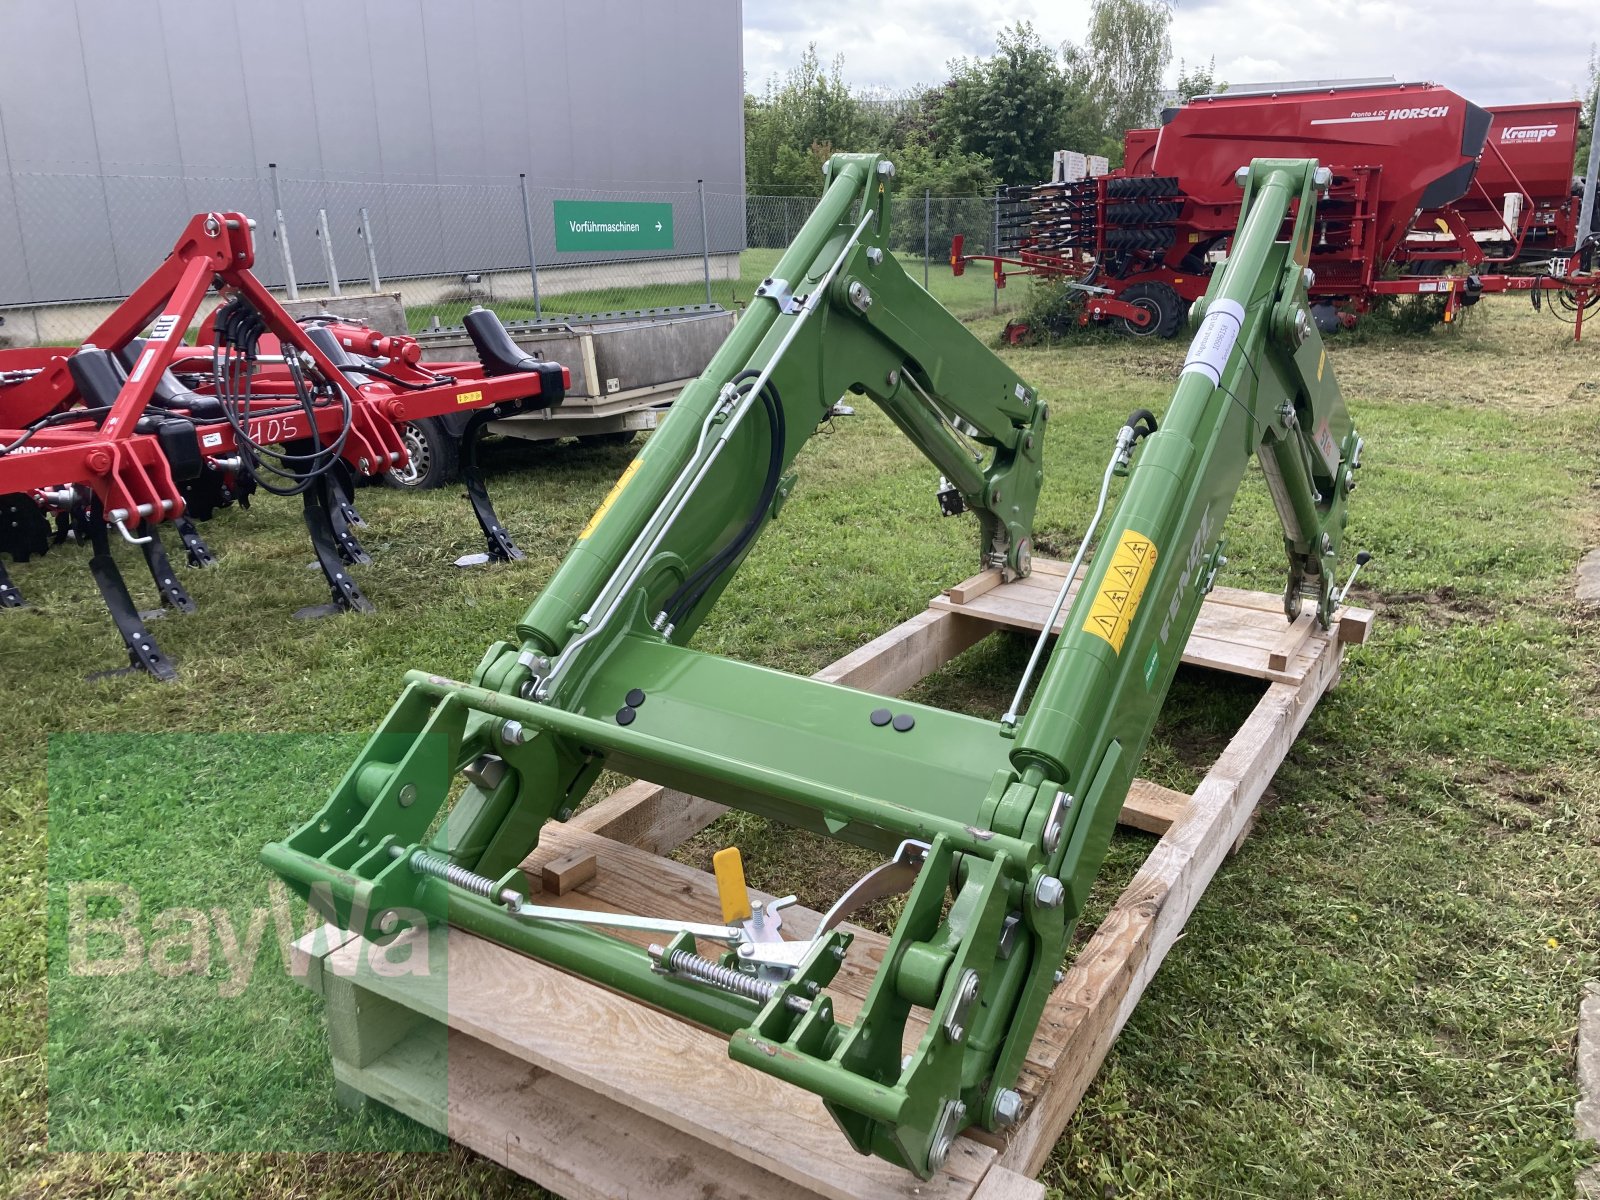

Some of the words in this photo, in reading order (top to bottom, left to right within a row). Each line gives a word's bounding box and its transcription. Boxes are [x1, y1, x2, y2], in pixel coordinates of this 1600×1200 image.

[1387, 106, 1450, 120] HORSCH
[1501, 125, 1558, 143] Krampe
[569, 220, 640, 232] Vorführmaschinen
[1160, 502, 1210, 645] FENDT
